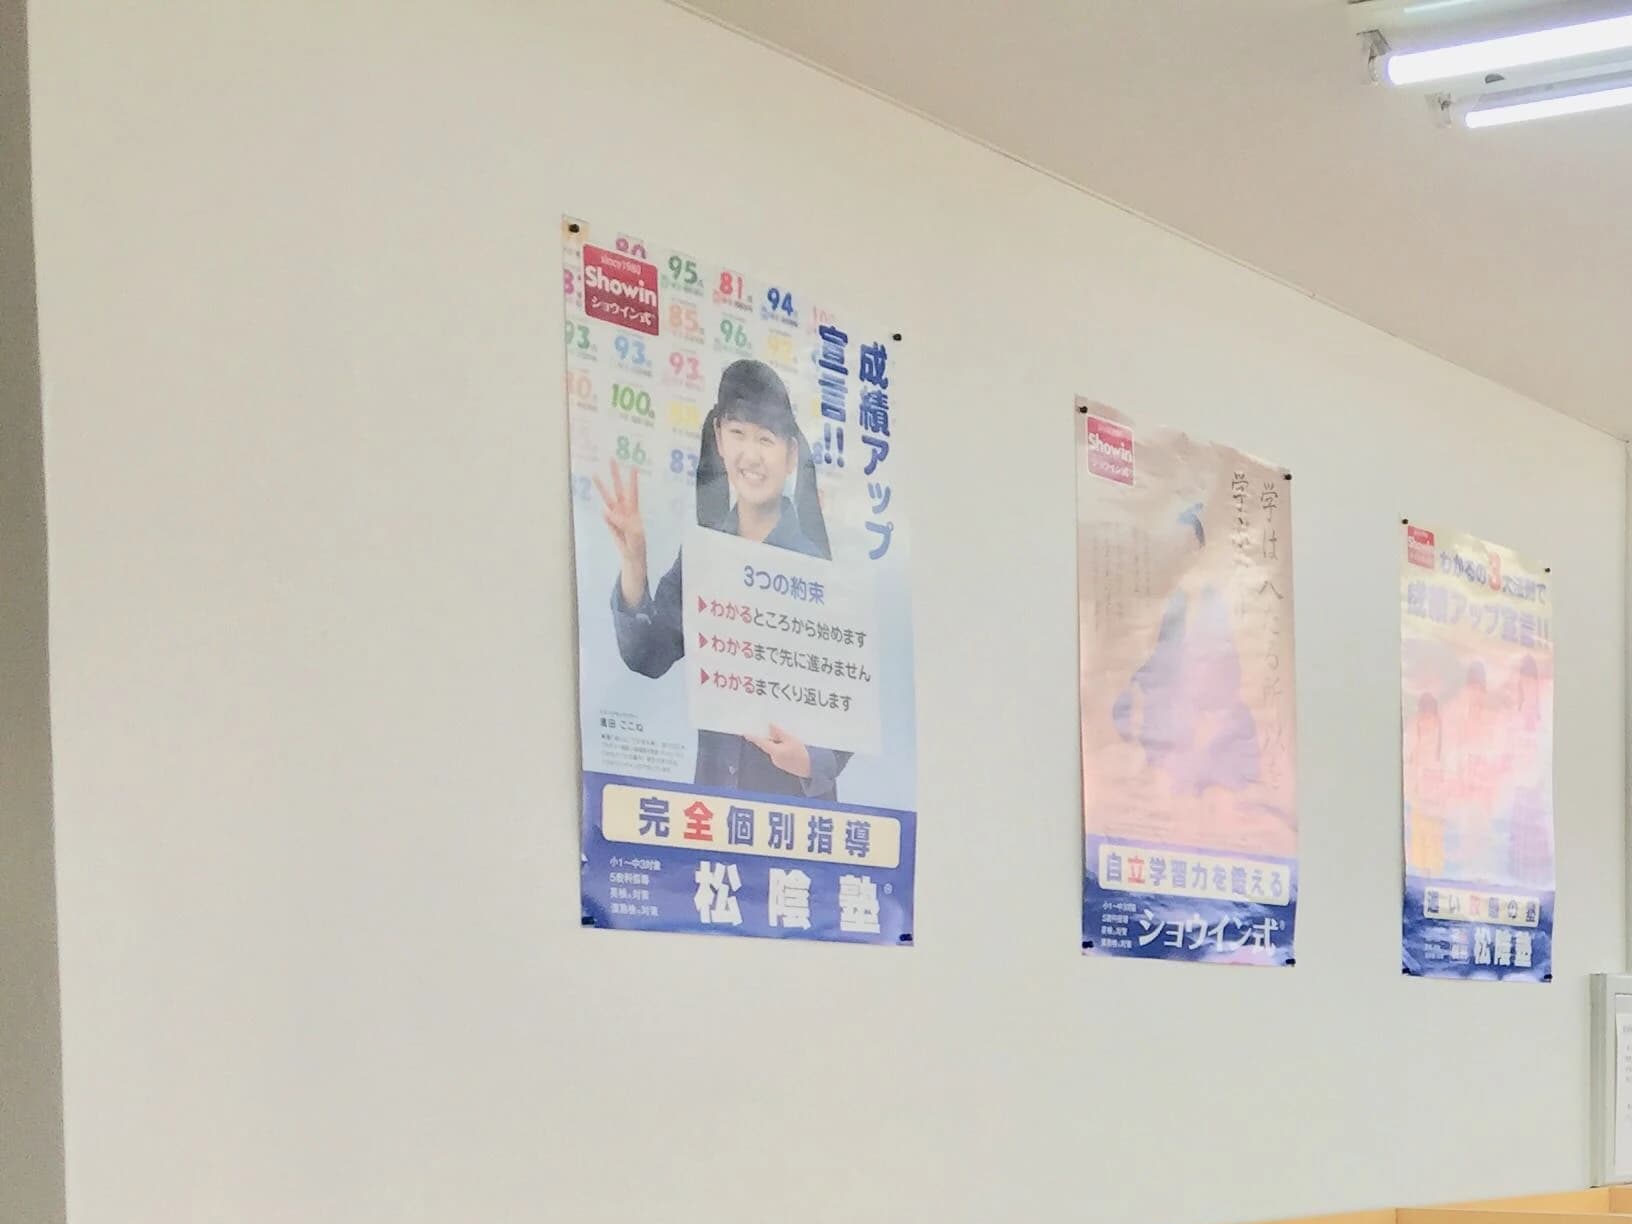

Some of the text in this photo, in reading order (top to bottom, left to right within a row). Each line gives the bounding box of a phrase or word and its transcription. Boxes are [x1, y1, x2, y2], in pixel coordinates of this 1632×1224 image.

[585, 264, 657, 307] Showin
[667, 255, 698, 285] 95
[719, 271, 744, 299] 81
[767, 287, 794, 316] 94
[614, 335, 646, 364] 93
[719, 319, 748, 347] 96
[611, 383, 652, 416] 100
[859, 341, 895, 560] 成績アップ
[1087, 432, 1133, 463] Showin
[743, 564, 825, 605] 3つの約束
[710, 598, 867, 649] わかるところから始めます
[711, 634, 872, 683] わかるまで先に進みません
[713, 671, 853, 712] わかるまでくり返します
[638, 796, 871, 859] 完全個別指導
